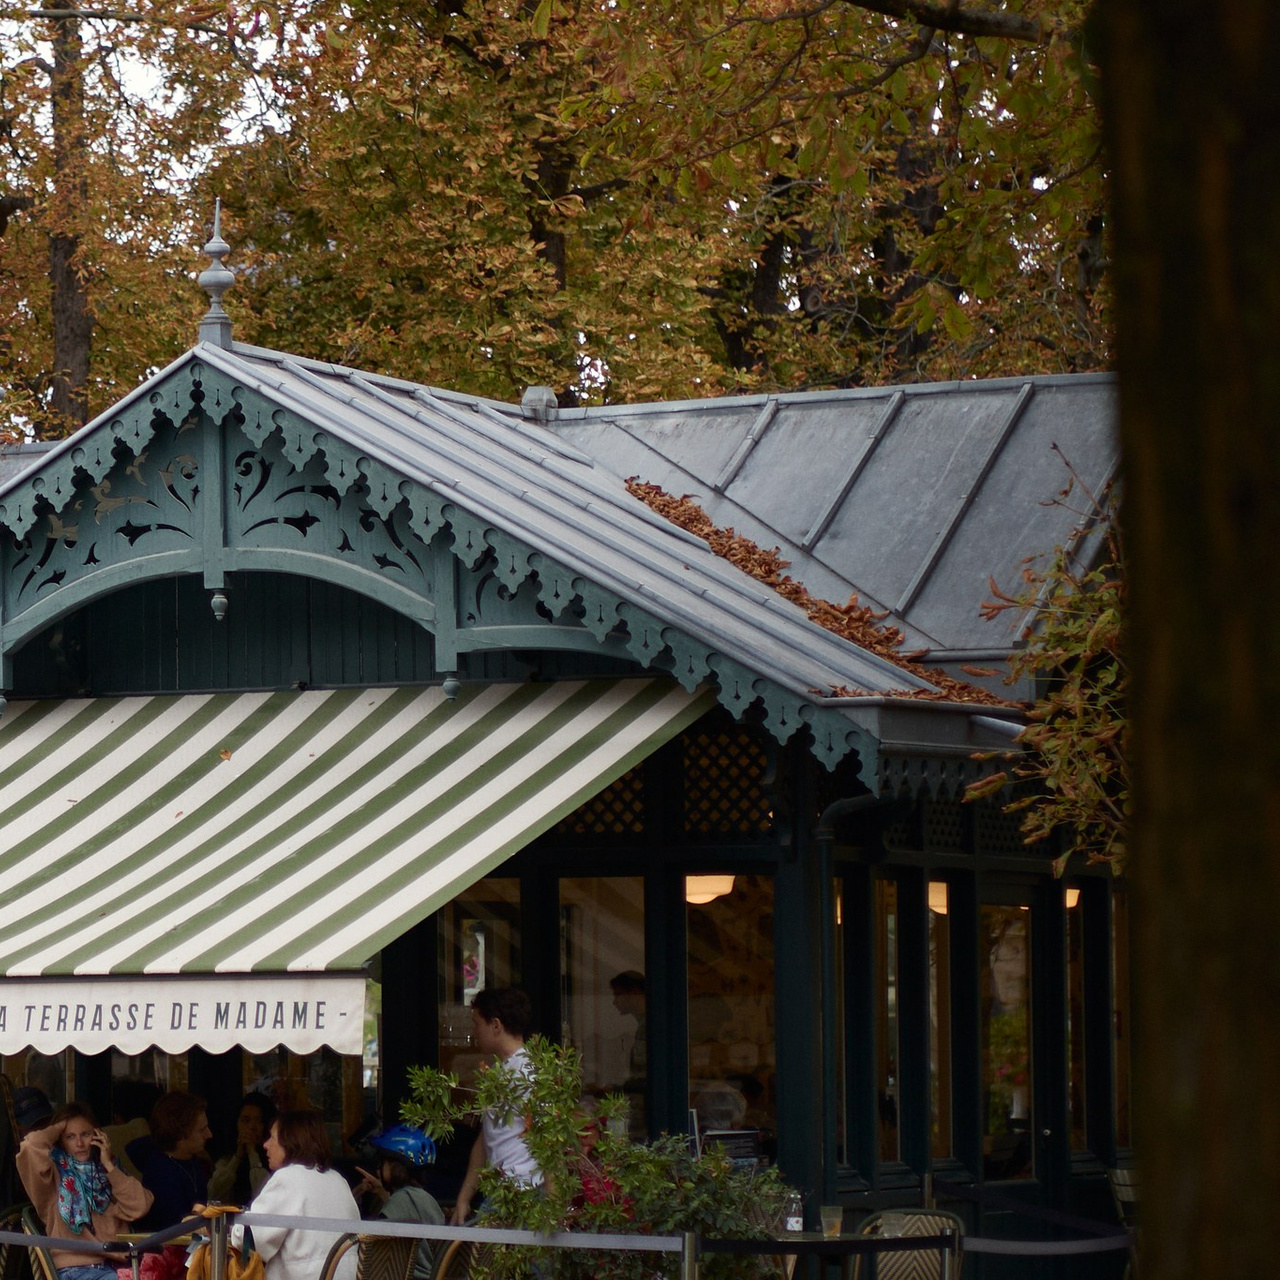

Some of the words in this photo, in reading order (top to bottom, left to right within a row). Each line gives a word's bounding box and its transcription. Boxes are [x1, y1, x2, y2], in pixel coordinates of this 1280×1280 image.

[24, 1003, 155, 1031] TERRASSE
[170, 1002, 199, 1029] DE
[214, 1001, 327, 1029] MADAME
